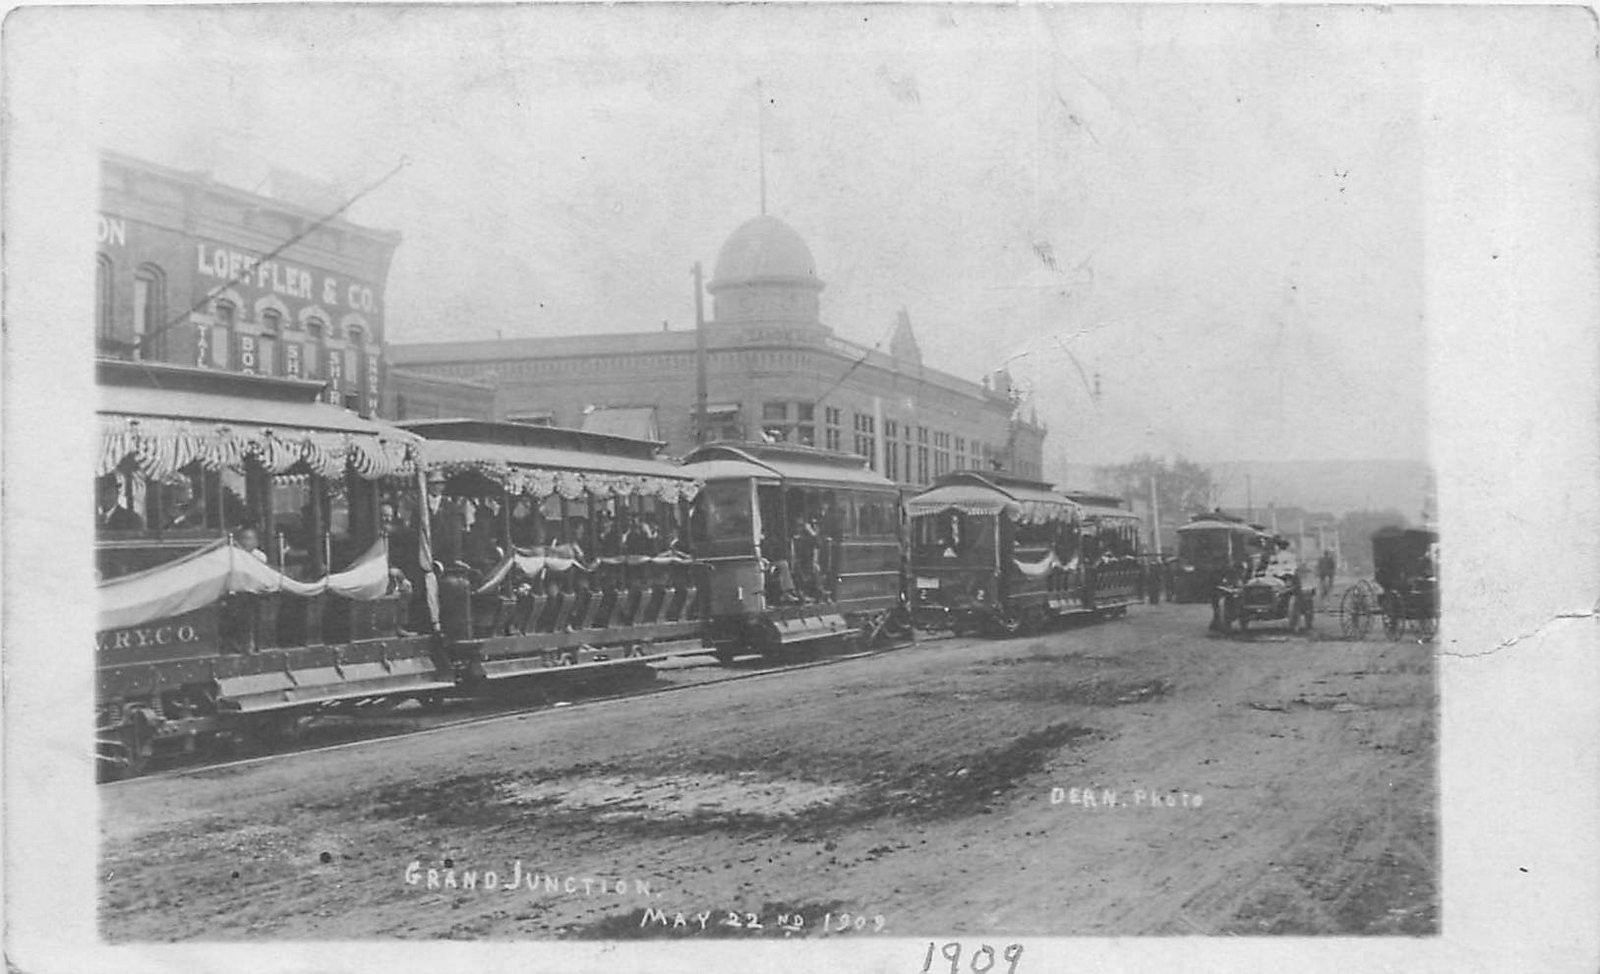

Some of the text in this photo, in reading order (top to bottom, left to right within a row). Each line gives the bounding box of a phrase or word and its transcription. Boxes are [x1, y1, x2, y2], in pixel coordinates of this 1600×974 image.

[198, 244, 312, 300] LOEFFLER
[323, 277, 338, 305] &
[923, 942, 1024, 974] 1909
